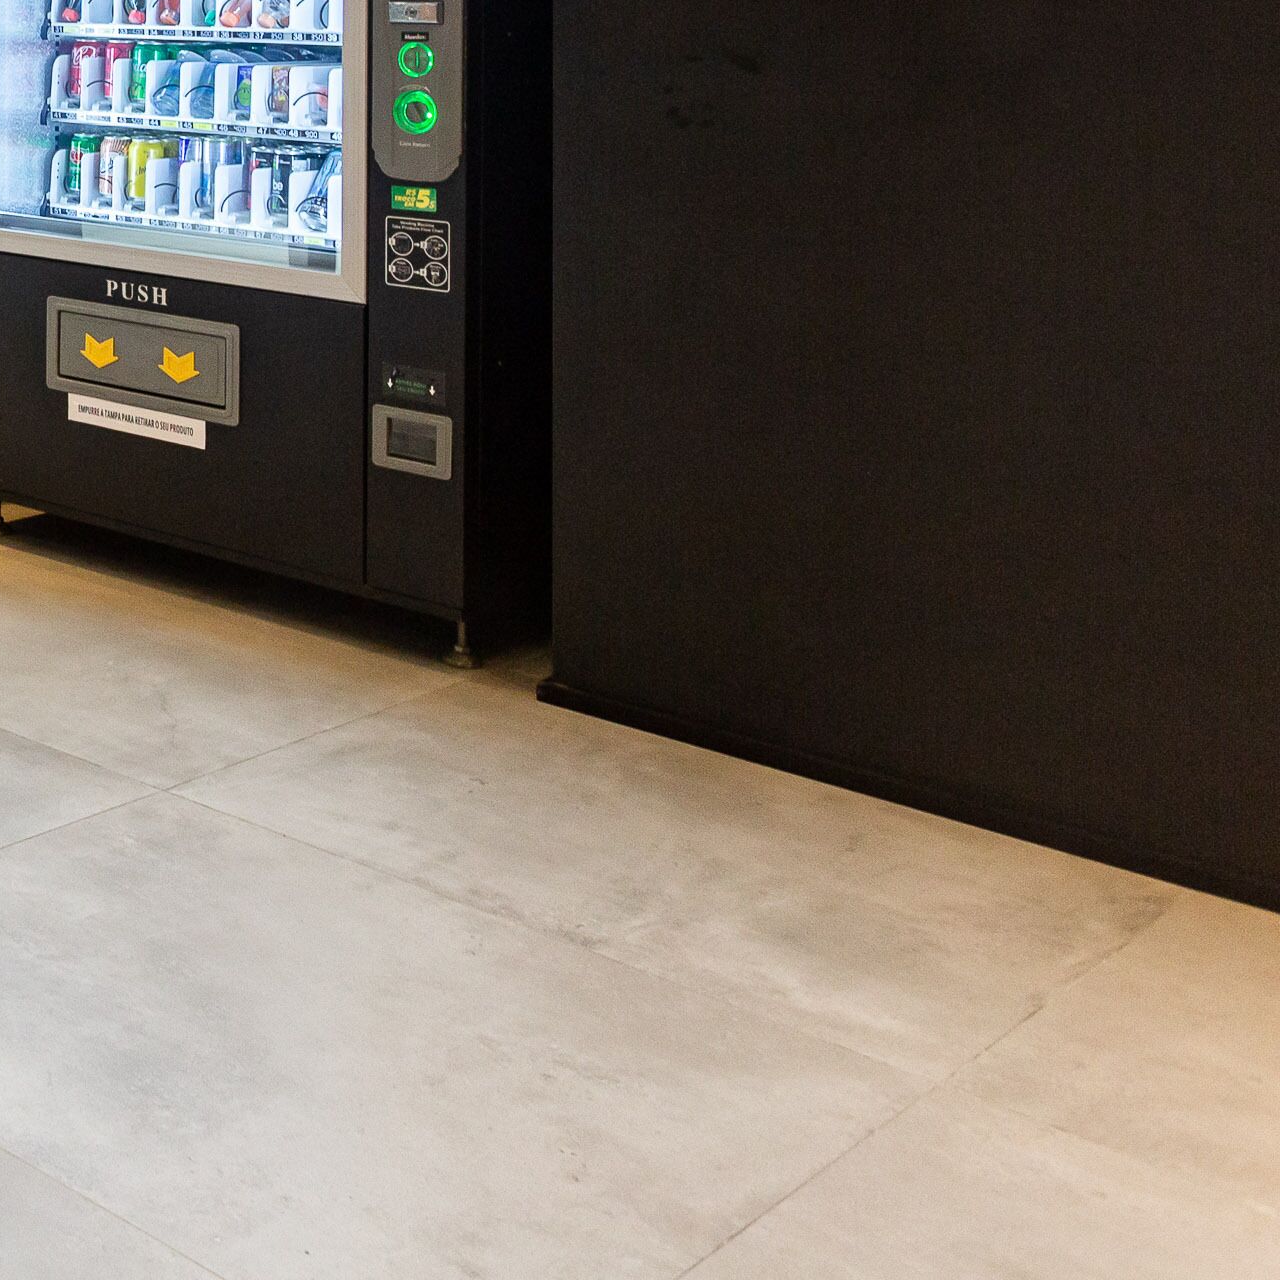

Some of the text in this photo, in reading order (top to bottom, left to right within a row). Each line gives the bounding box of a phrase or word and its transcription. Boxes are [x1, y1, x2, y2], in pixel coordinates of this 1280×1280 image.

[106, 279, 168, 306] PUSH
[78, 404, 100, 417] EMPURRE
[104, 409, 121, 421] TAMPA
[121, 413, 134, 424] PARA
[135, 416, 155, 428] RETIRAR
[160, 421, 169, 431] SEU
[169, 423, 194, 437] PRODUTO
